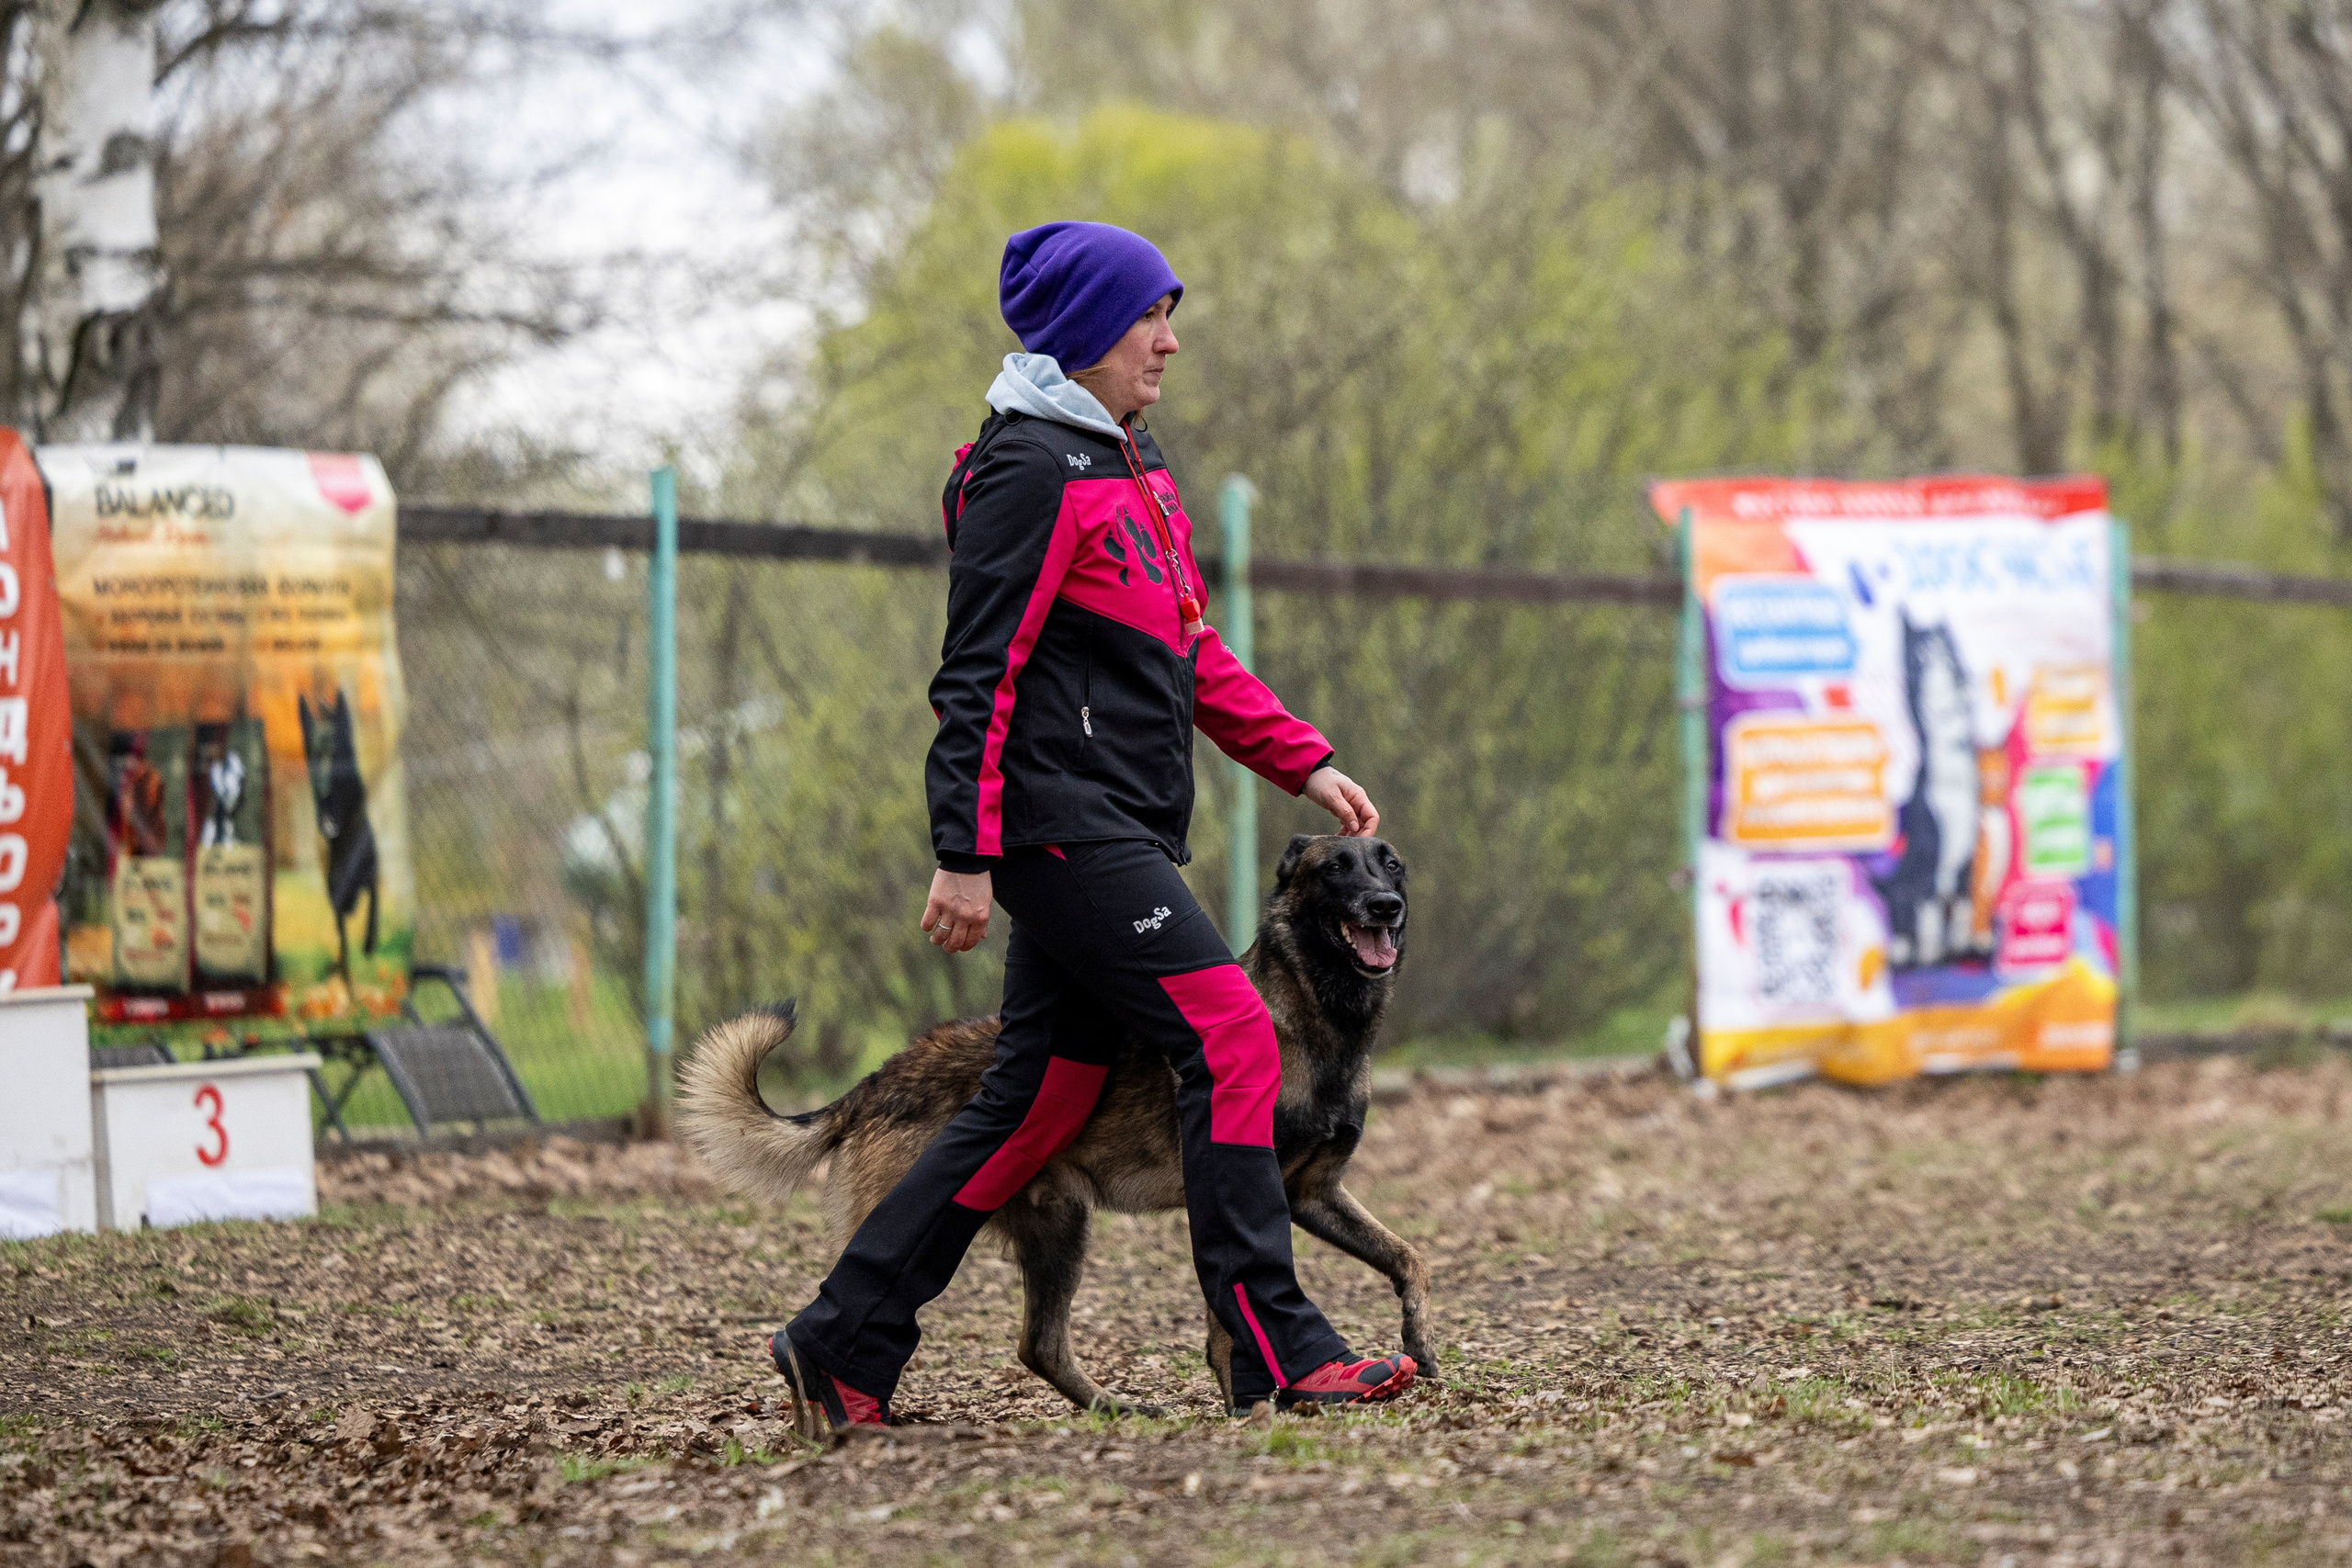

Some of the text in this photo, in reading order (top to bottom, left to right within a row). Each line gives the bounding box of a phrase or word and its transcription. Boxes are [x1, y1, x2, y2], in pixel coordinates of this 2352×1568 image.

[1066, 453, 1092, 471] DogSa
[95, 482, 235, 520] BALANCED
[1133, 906, 1172, 934] DogSa
[194, 1084, 229, 1168] 3
